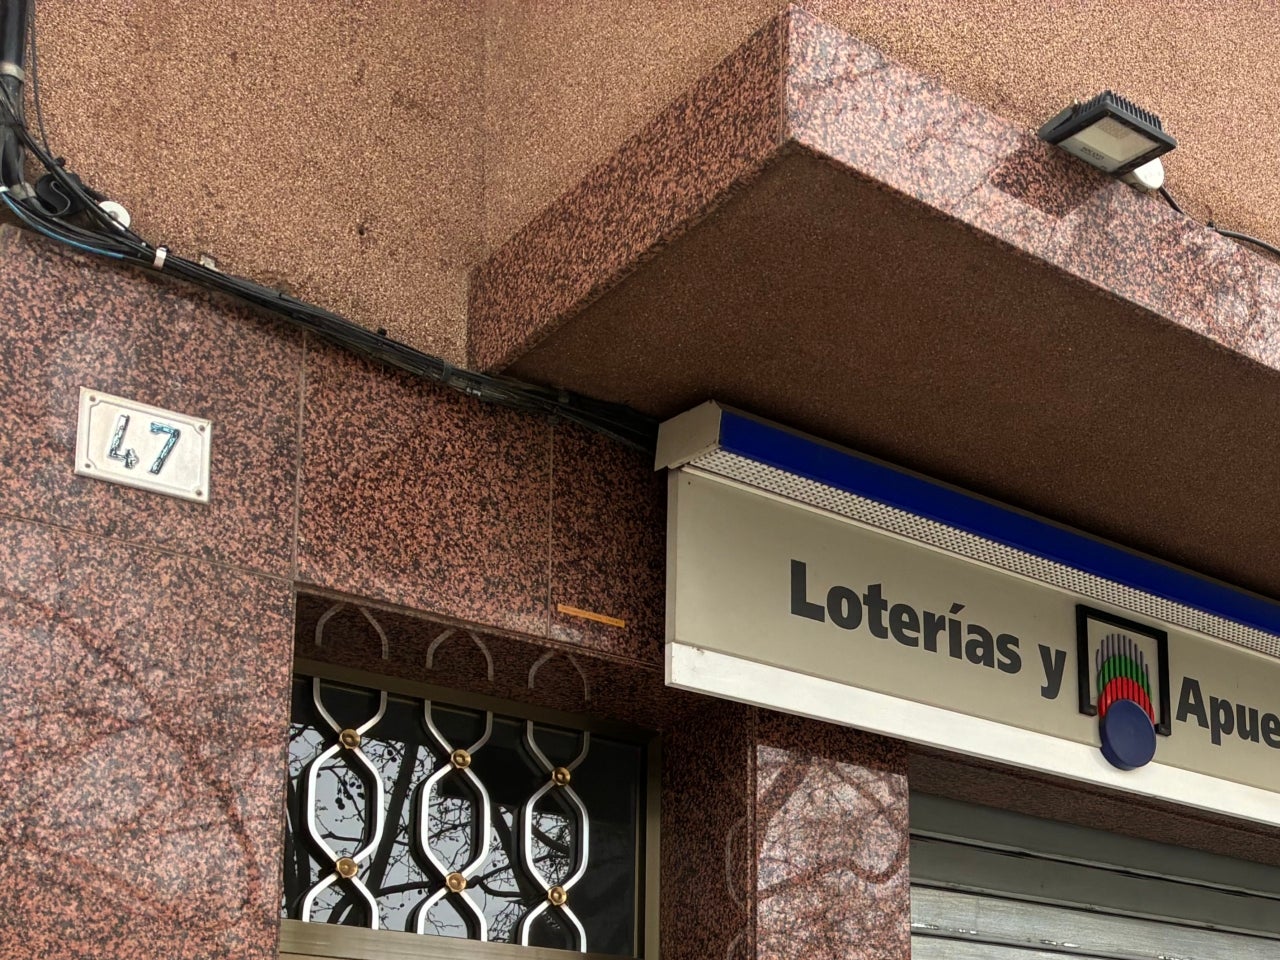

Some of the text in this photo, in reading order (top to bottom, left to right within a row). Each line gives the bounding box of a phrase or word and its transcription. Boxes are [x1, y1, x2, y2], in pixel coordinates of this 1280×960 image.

[107, 413, 182, 476] 47
[790, 558, 1068, 701] Loterías y
